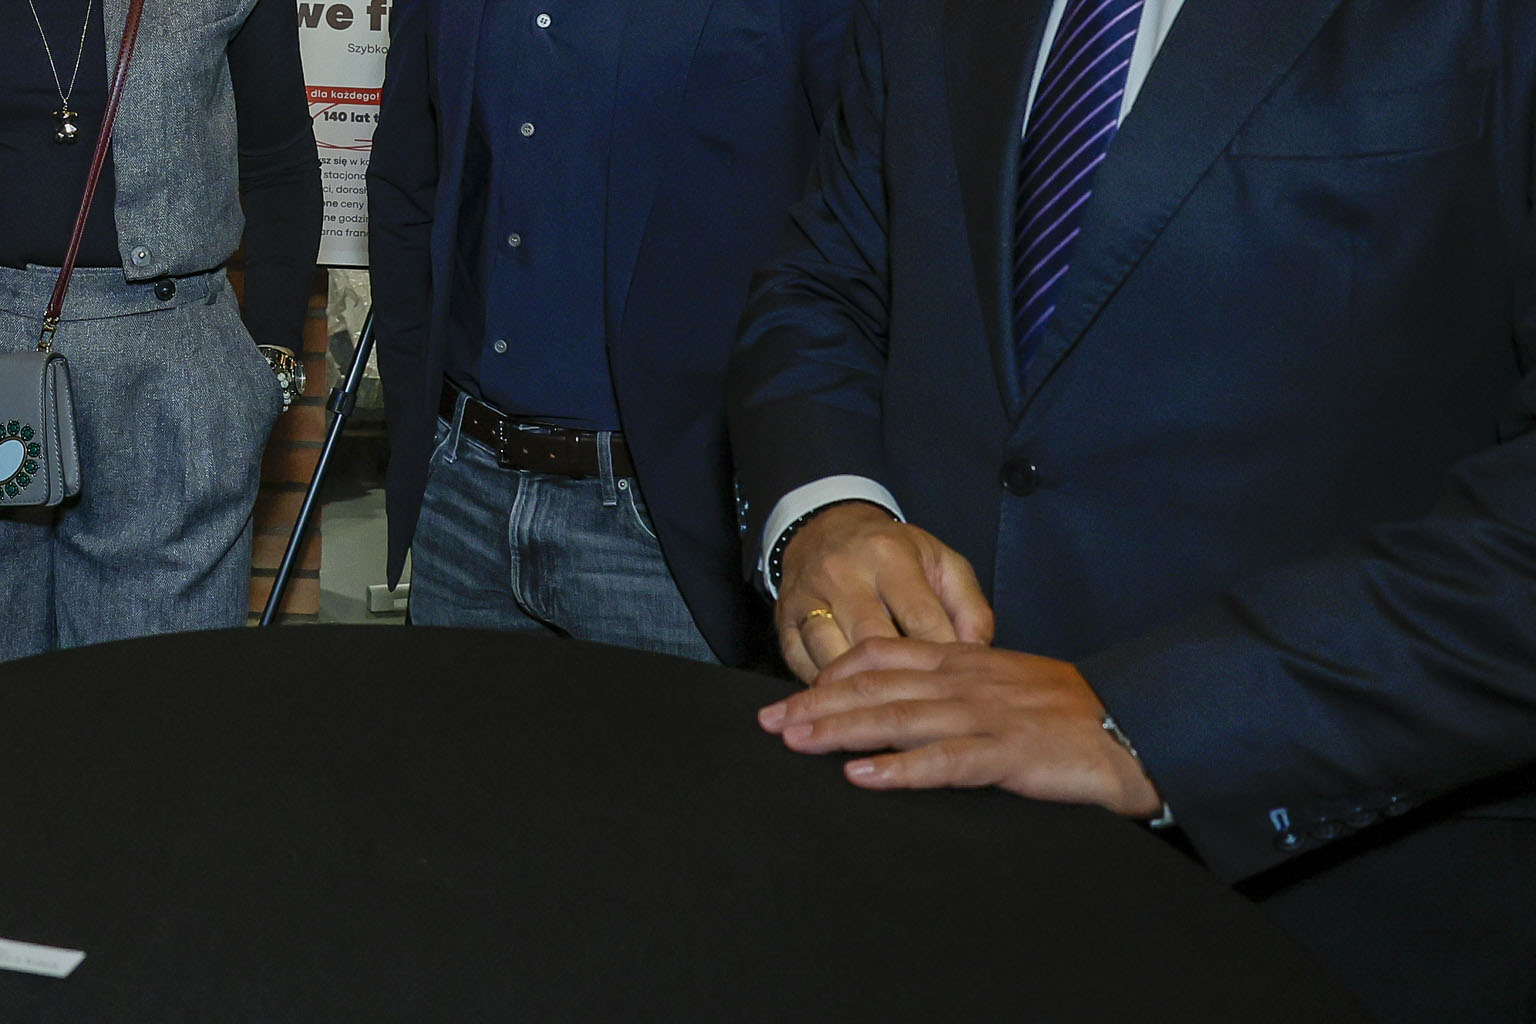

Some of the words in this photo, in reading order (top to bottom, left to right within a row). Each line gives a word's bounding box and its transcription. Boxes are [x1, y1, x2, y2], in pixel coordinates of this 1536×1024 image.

[311, 89, 328, 98] dla
[331, 90, 380, 102] każdego!
[324, 111, 348, 122] 140
[351, 112, 371, 123] lat
[334, 157, 348, 167] się
[340, 201, 365, 210] ceny
